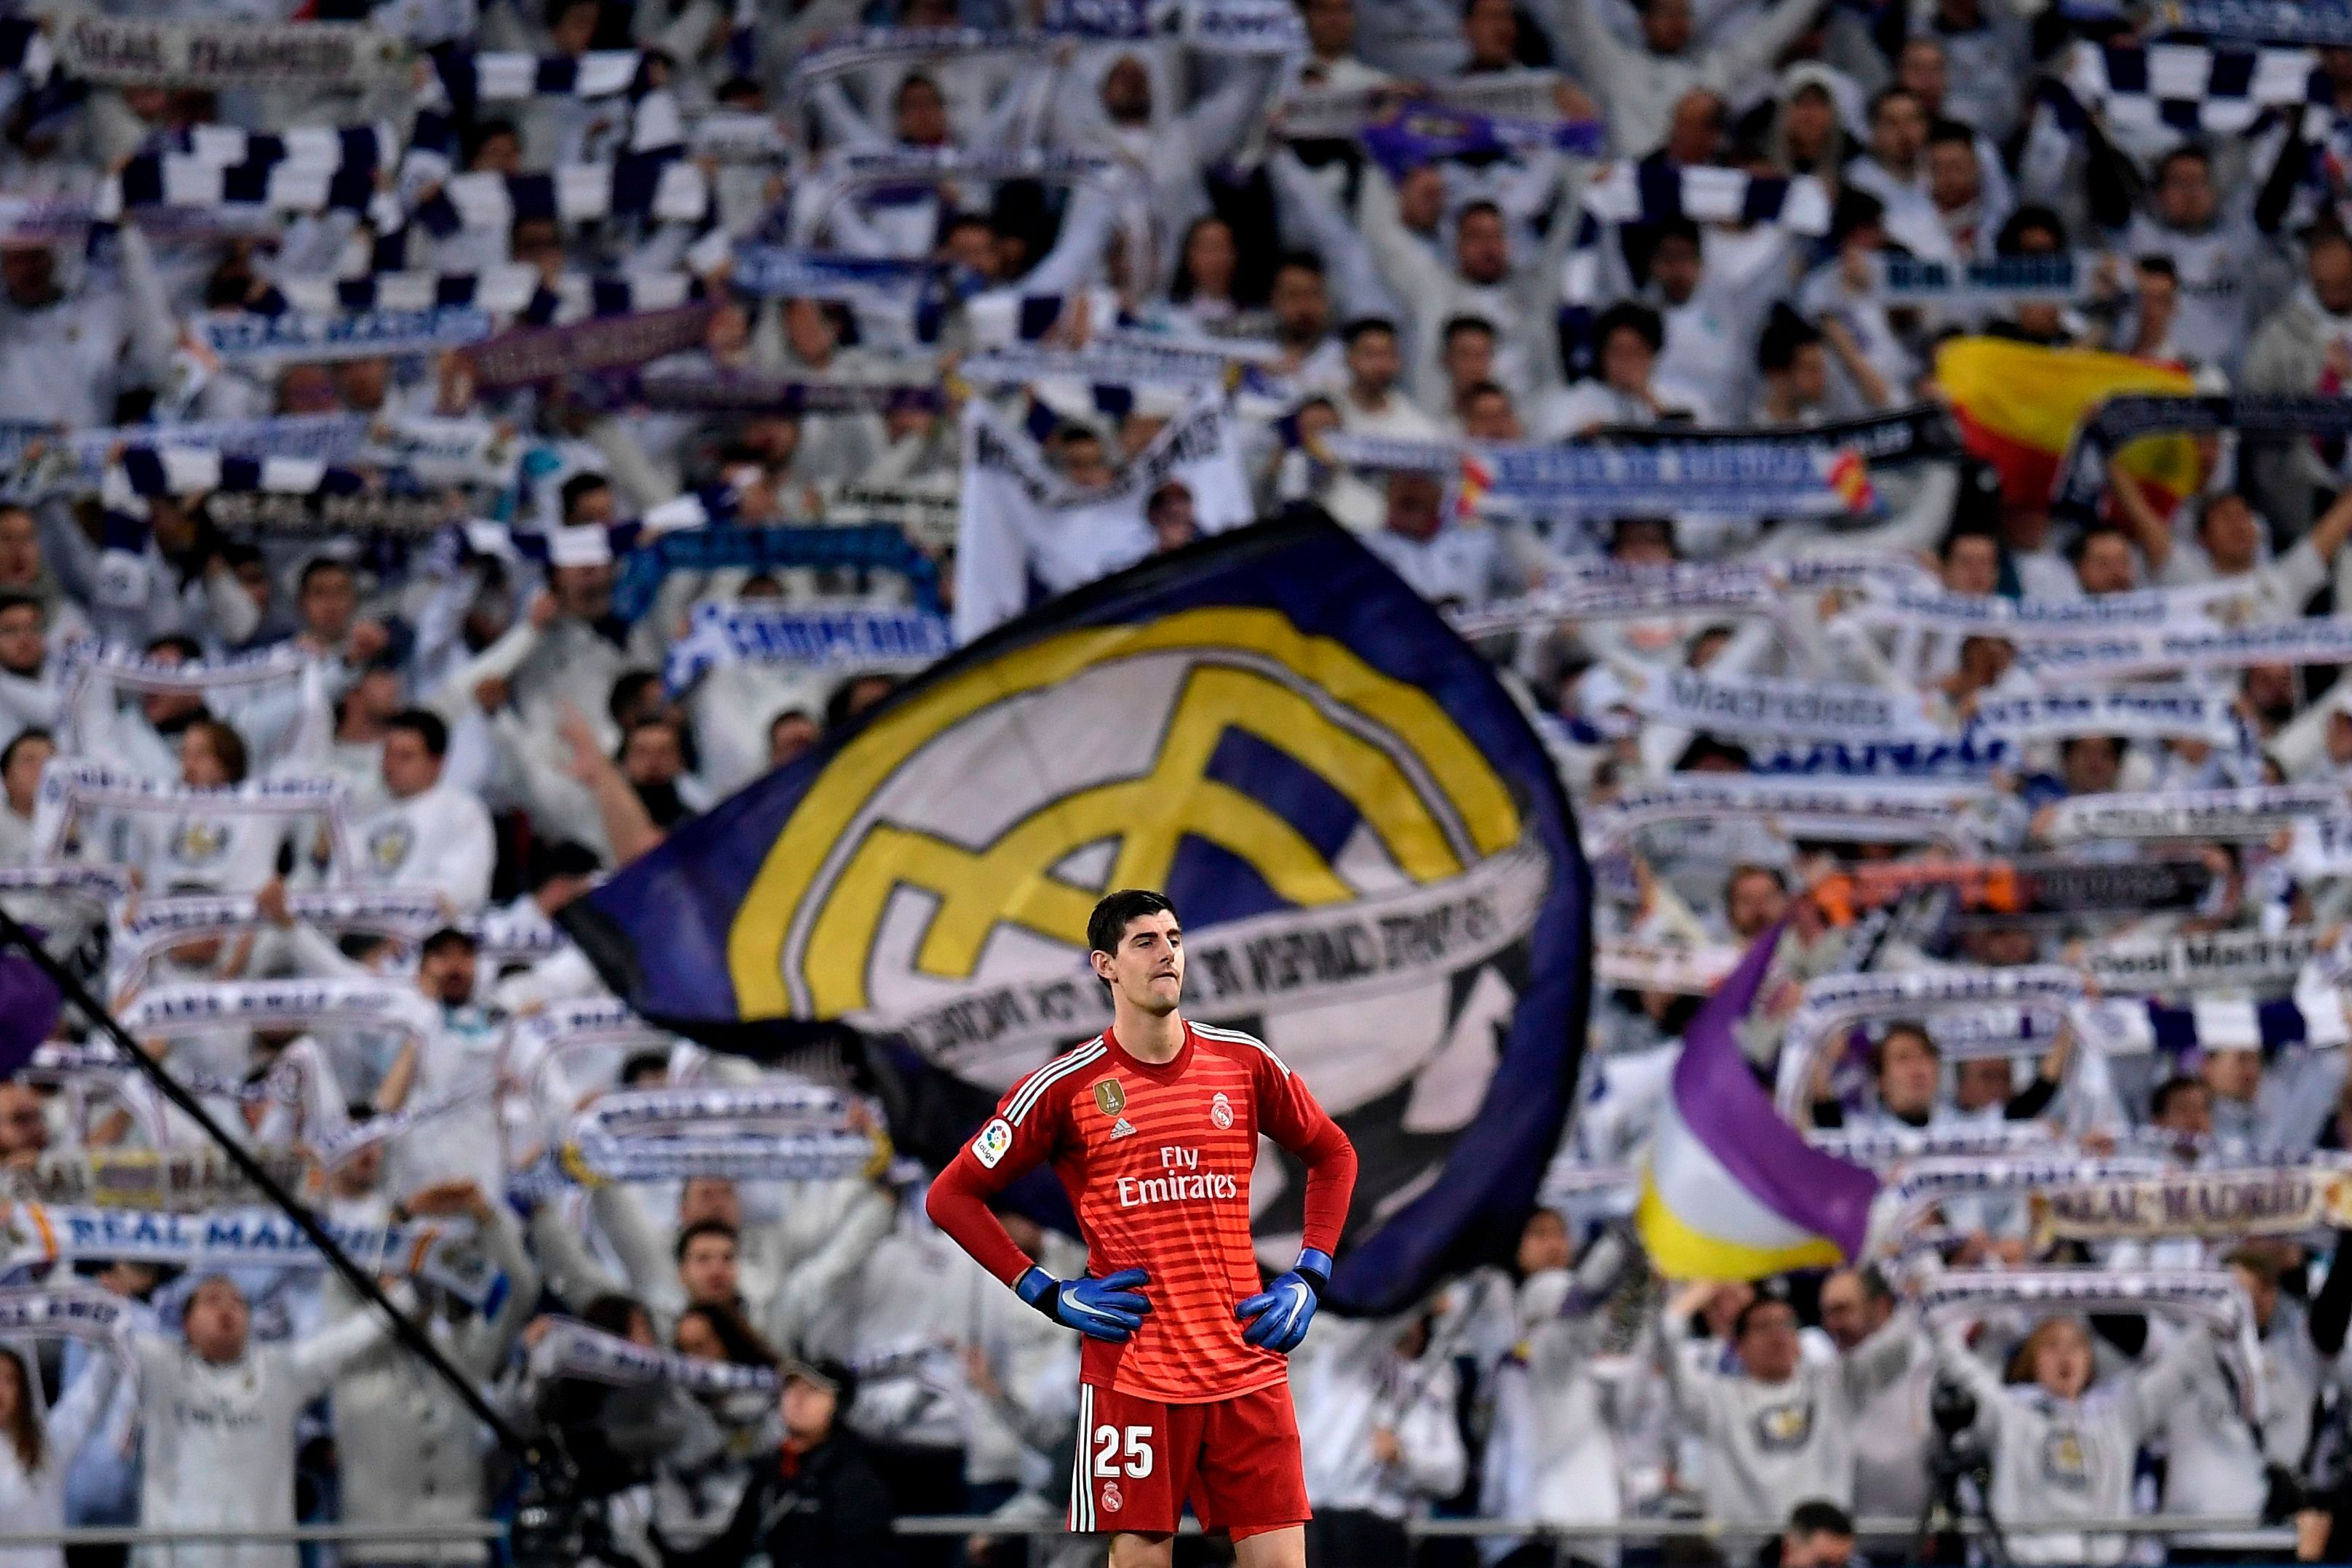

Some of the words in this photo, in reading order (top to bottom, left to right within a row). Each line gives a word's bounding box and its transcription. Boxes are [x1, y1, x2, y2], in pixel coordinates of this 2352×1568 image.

[1110, 1127, 1137, 1139] adidas
[977, 1141, 994, 1163] LaLiga
[1160, 1146, 1198, 1171] Fly
[1117, 1170, 1238, 1208] Emirates
[1094, 1425, 1153, 1479] 25
